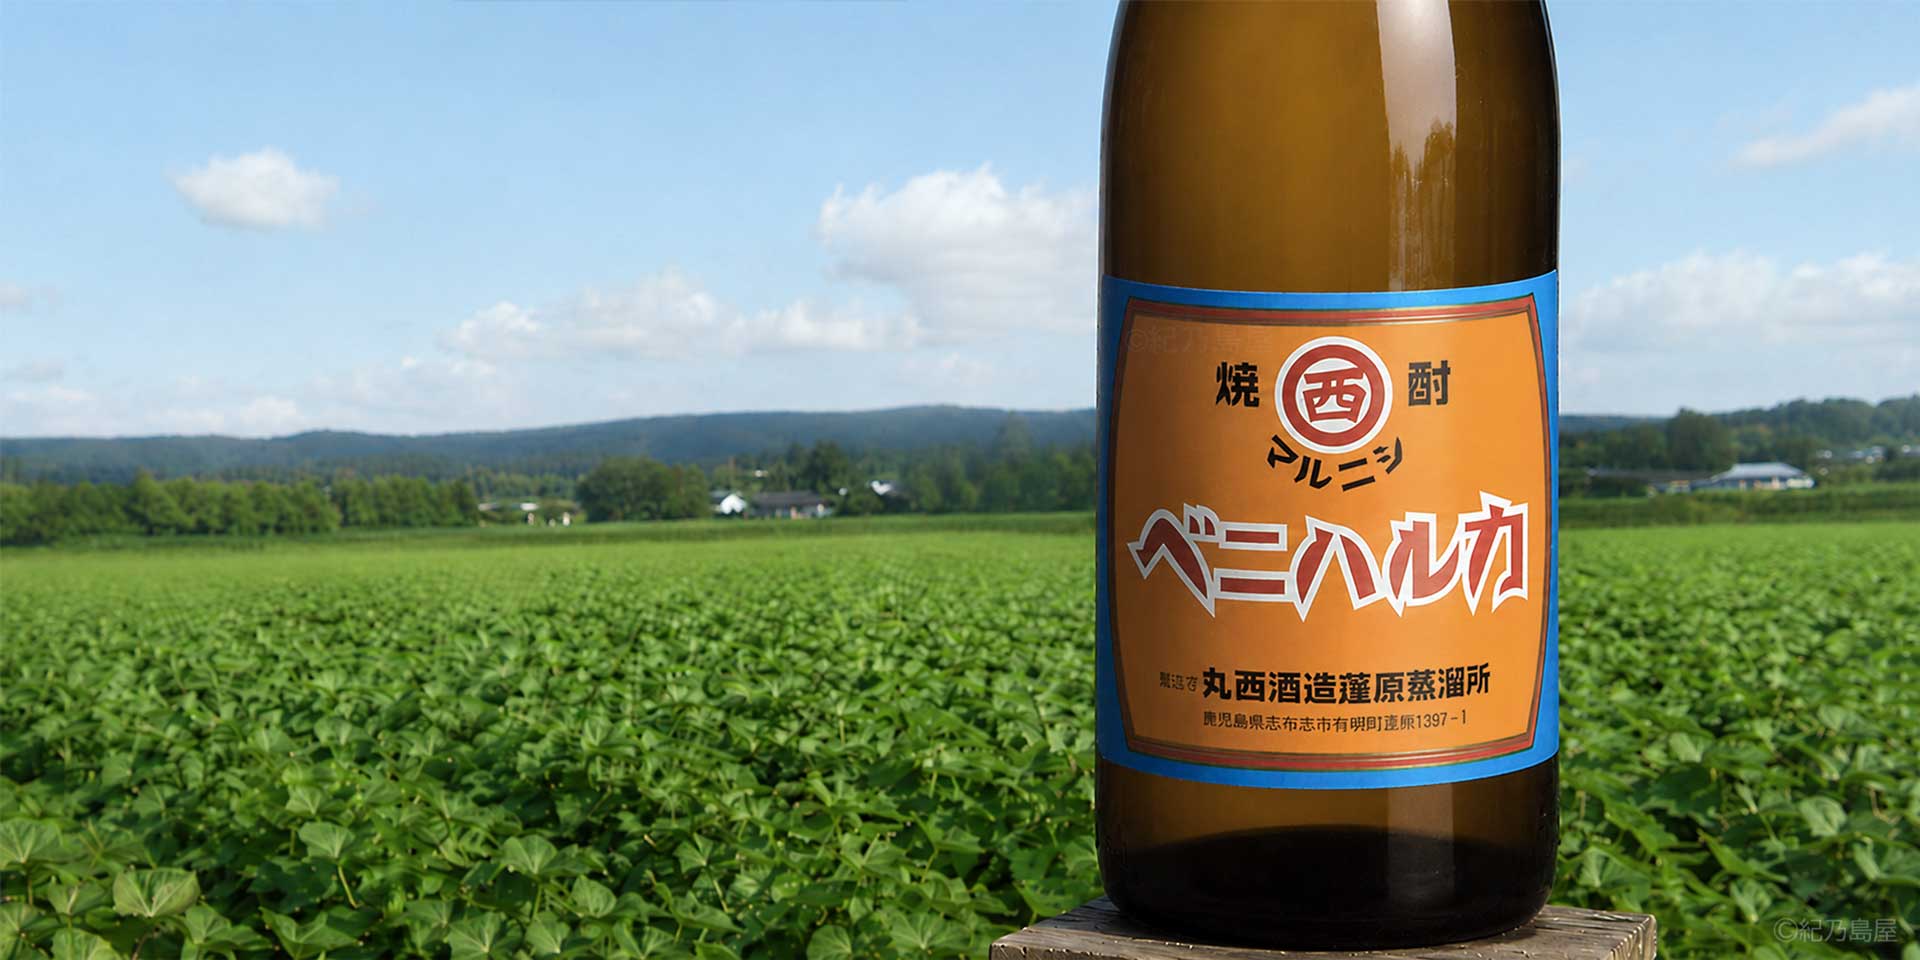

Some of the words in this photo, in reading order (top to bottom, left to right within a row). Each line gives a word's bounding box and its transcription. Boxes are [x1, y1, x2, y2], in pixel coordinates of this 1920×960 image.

[1215, 361, 1259, 407] 焼
[1408, 359, 1451, 406] 酎
[1267, 434, 1402, 492] マルニシ
[1127, 490, 1528, 623] ベニハルカ
